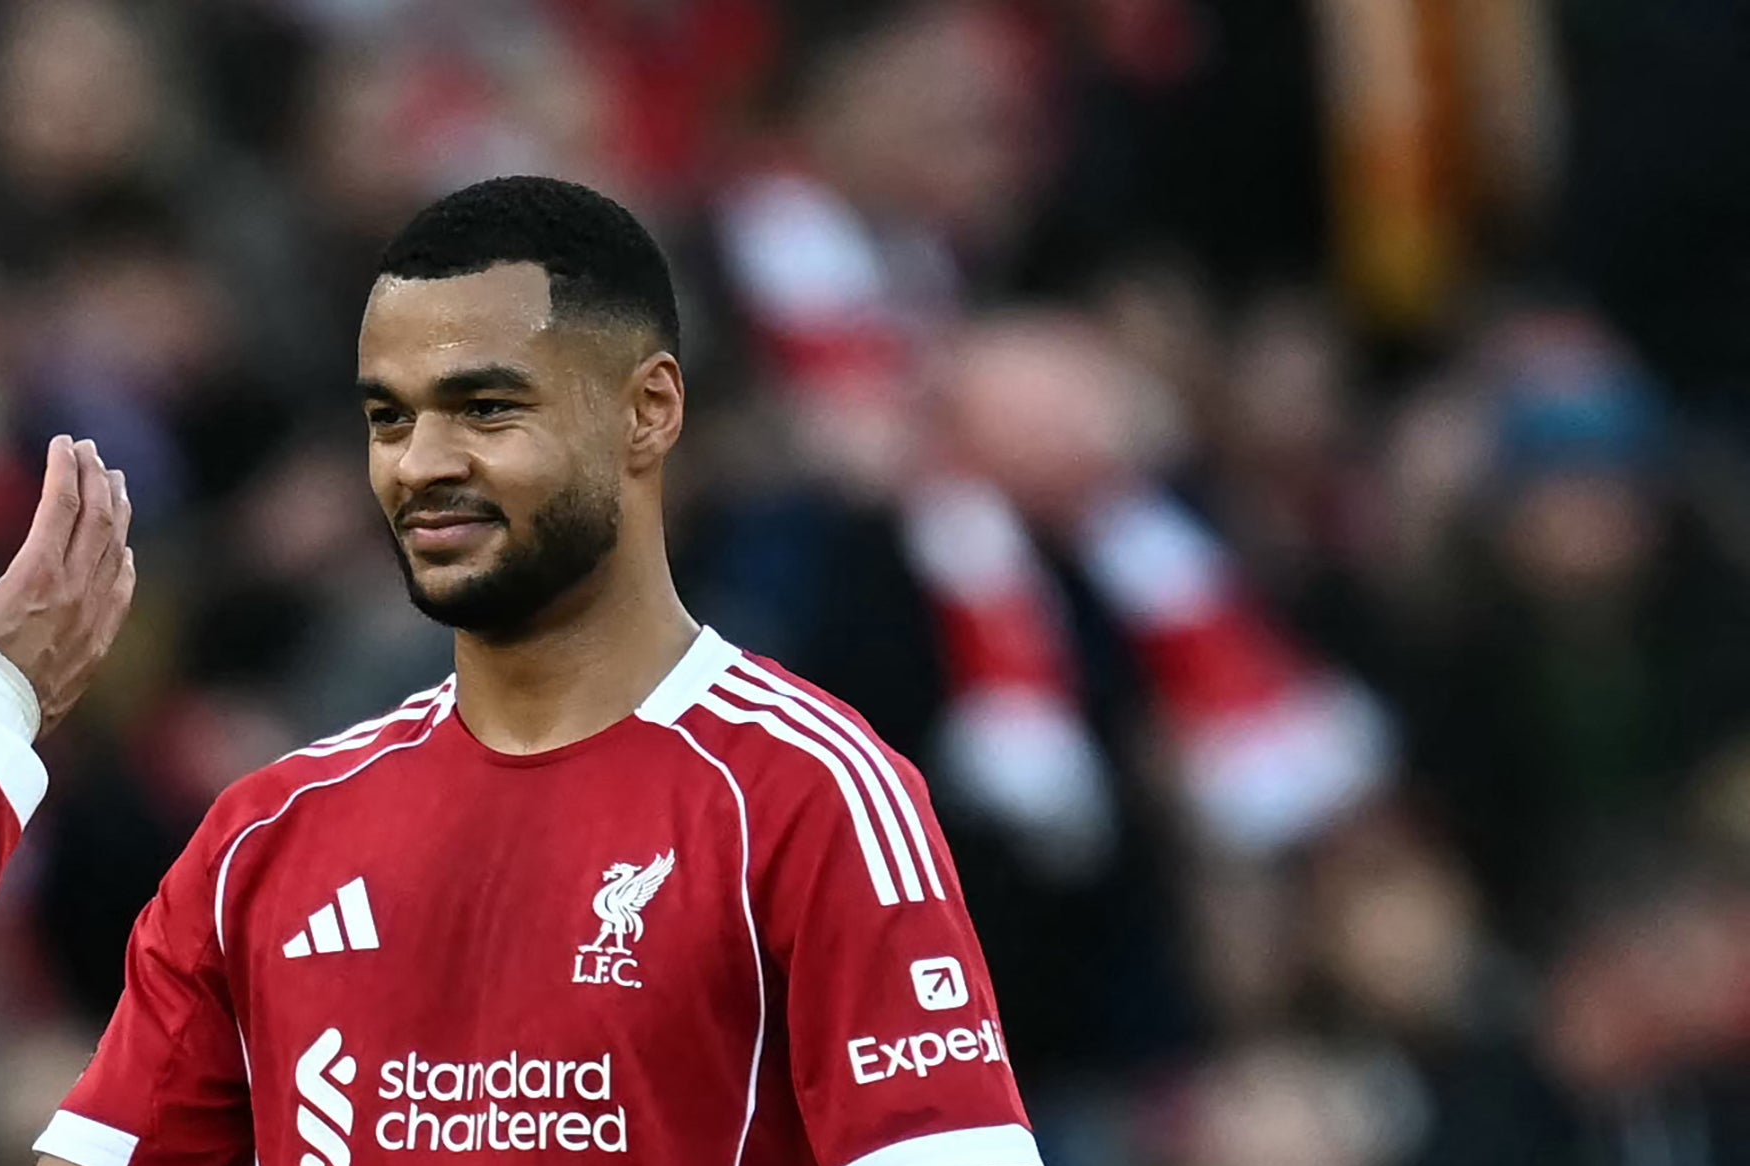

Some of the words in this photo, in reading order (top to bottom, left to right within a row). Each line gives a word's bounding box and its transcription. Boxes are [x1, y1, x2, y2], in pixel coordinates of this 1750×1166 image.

[378, 1050, 611, 1101] standard
[847, 1019, 1009, 1085] Expedi
[375, 1101, 627, 1153] chartered
